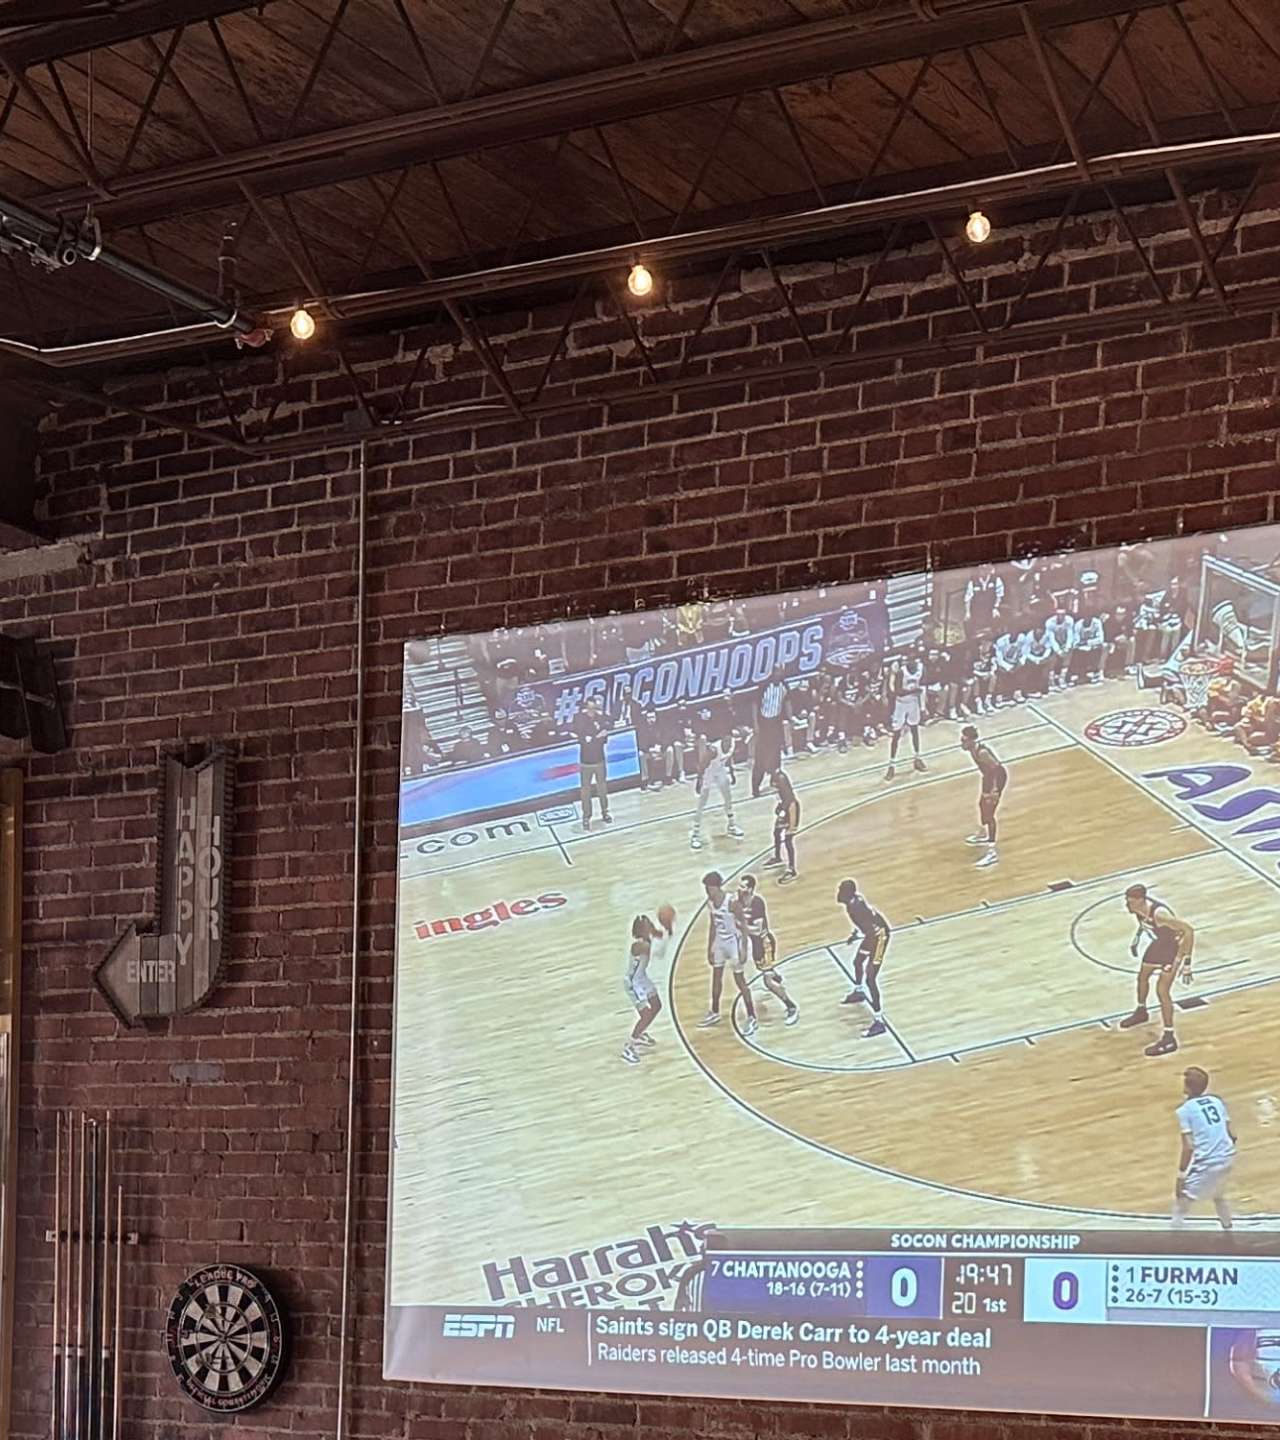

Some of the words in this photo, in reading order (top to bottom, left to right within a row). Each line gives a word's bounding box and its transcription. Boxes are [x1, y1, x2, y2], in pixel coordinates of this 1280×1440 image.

[174, 796, 196, 966] HAPPY
[197, 815, 221, 940] HOUR
[413, 892, 568, 940] ingles
[127, 960, 176, 983] ENTER
[1201, 1105, 1221, 1125] 13
[890, 1233, 947, 1248] SOCON
[951, 1234, 1081, 1250] CHAMPIONSHIP
[711, 1260, 720, 1277] 7
[722, 1260, 851, 1279] CHATTANOOGA
[1125, 1266, 1134, 1284] 1
[1140, 1266, 1239, 1286] FURMAN
[766, 1281, 806, 1296] 18-16
[809, 1281, 852, 1298] (7-11)
[891, 1267, 918, 1307] 0
[1052, 1271, 1079, 1311] 0
[1125, 1288, 1163, 1303] 26-7
[1167, 1288, 1219, 1306] (15-3)
[951, 1291, 977, 1314] 20
[982, 1298, 1007, 1313] 1st
[443, 1314, 516, 1338] ESPN
[536, 1317, 565, 1333] NFL
[595, 1315, 654, 1336] Saints
[658, 1318, 698, 1341] sign
[703, 1318, 732, 1341] QB
[737, 1320, 794, 1341] Derek
[799, 1322, 844, 1343] Carr
[848, 1324, 870, 1344] to
[874, 1324, 942, 1349] 4-year
[946, 1326, 992, 1348] deal
[598, 1342, 657, 1363] Raiders
[660, 1344, 727, 1366] released
[730, 1347, 786, 1368] 4-time
[789, 1349, 818, 1369] Pro
[822, 1350, 881, 1372] Bowler
[885, 1353, 918, 1373] last
[921, 1356, 981, 1376] month
